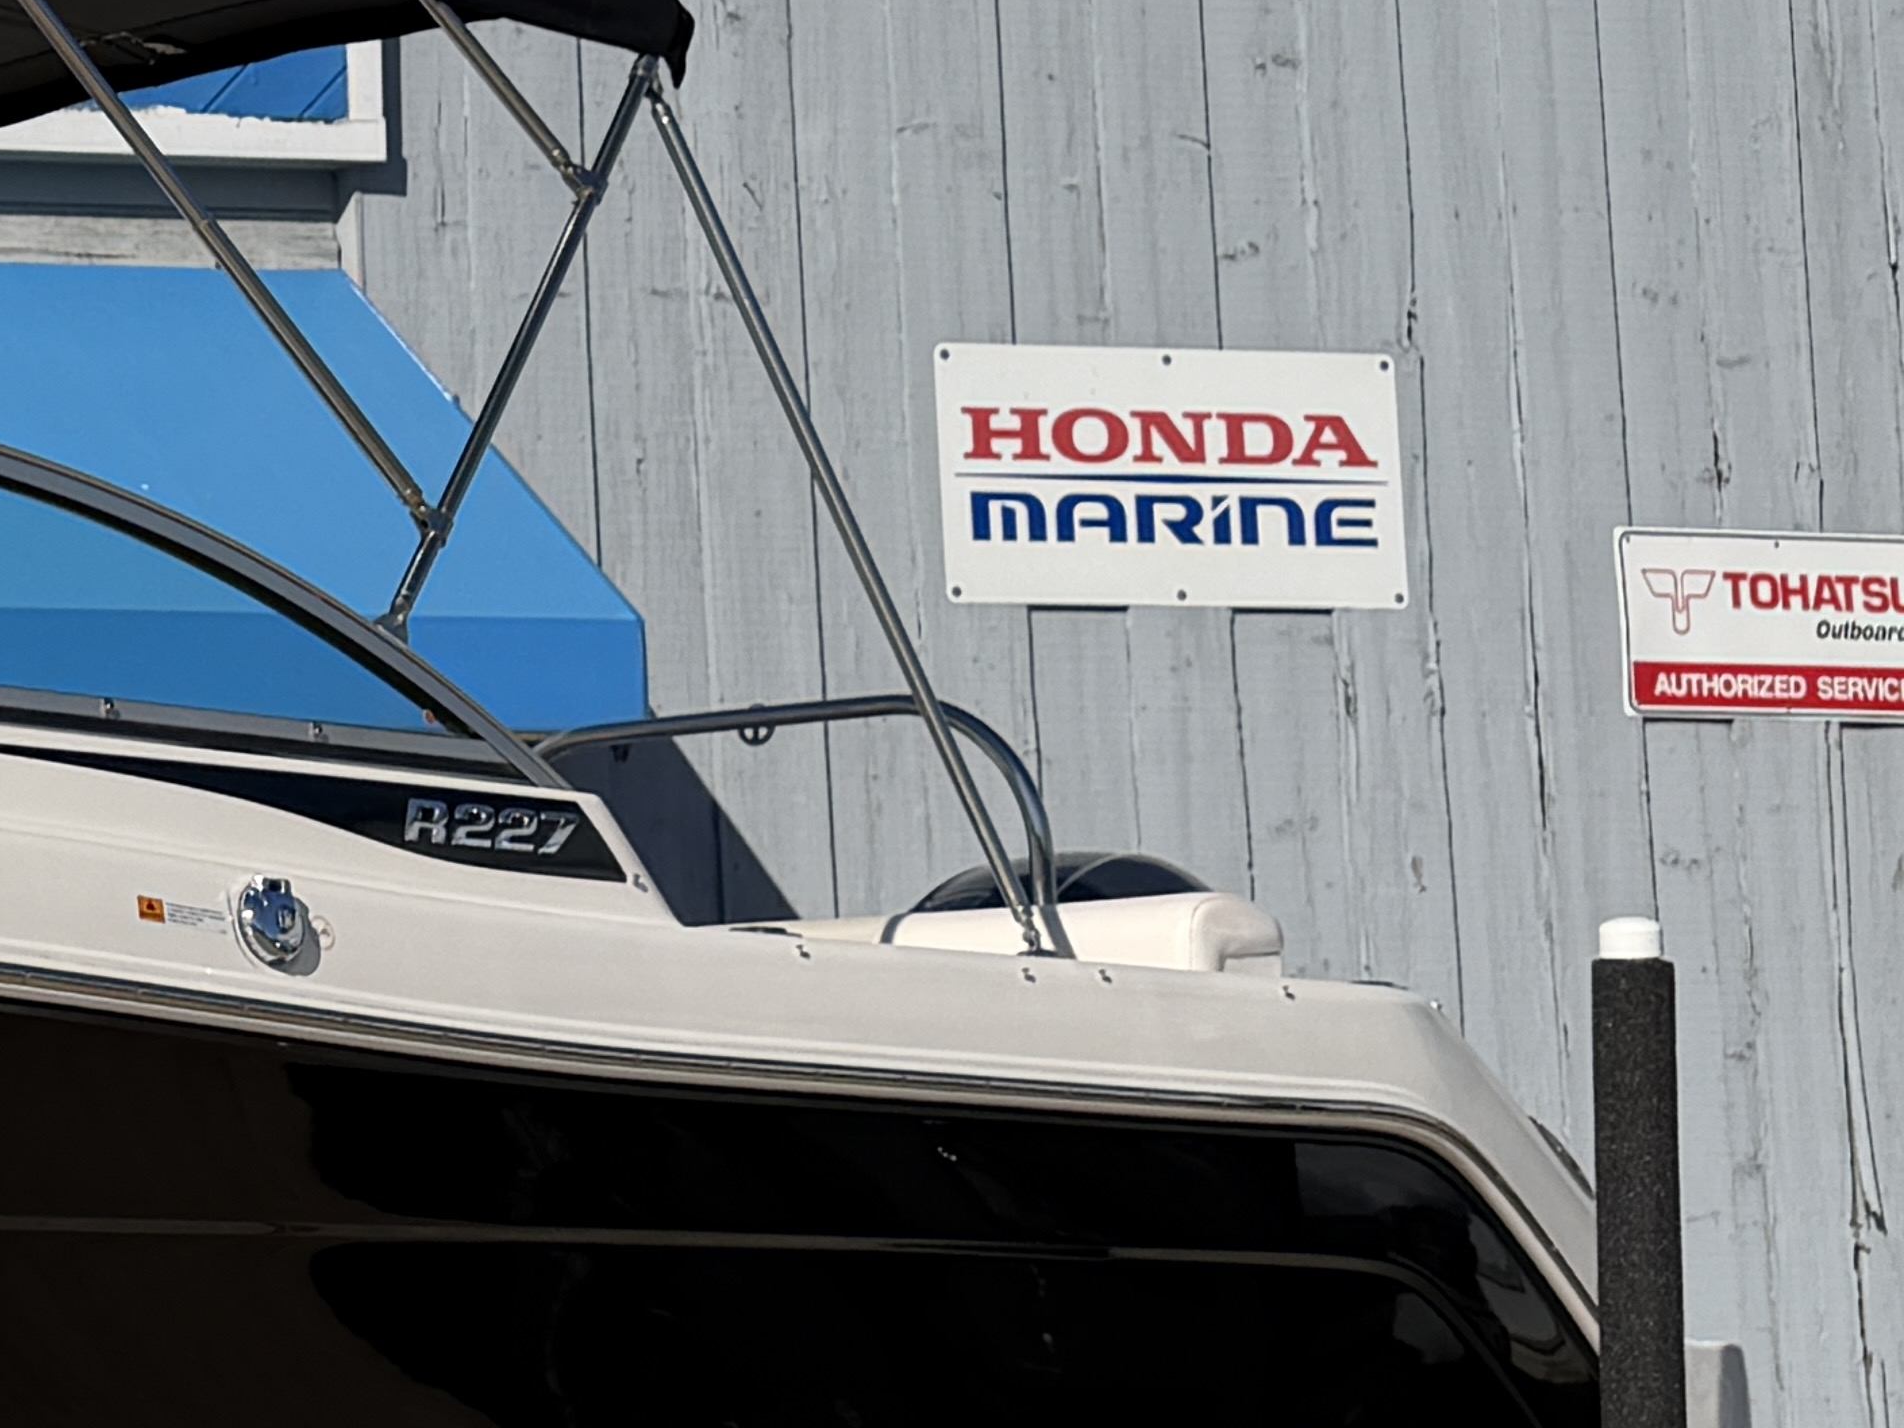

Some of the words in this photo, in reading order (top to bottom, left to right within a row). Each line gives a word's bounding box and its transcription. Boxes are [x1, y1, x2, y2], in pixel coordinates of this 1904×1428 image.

[961, 406, 1379, 468] HONDA
[1654, 672, 1807, 699] AUTHORIZED
[405, 798, 579, 855] R227
